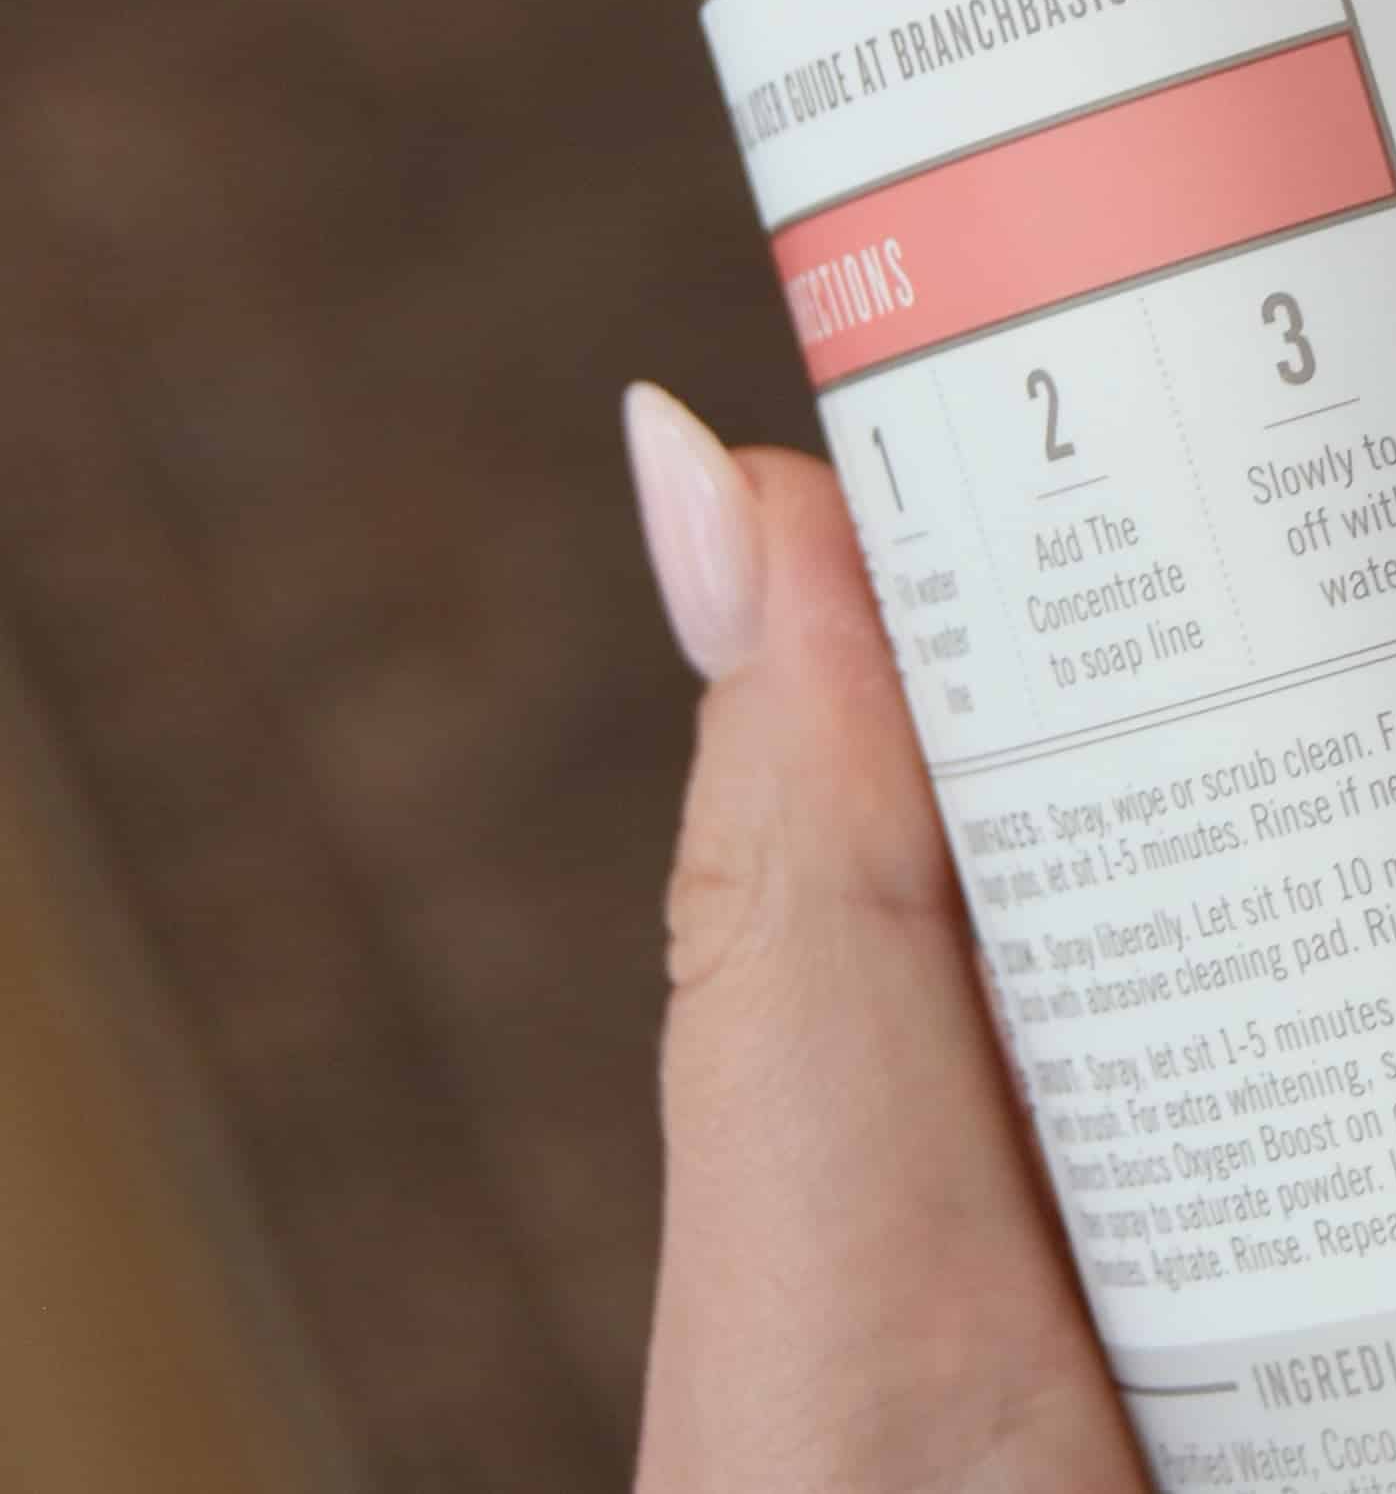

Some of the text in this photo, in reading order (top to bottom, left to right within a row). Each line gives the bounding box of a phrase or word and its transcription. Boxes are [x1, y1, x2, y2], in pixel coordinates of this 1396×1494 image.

[784, 51, 854, 123] GUIDE
[853, 35, 888, 96] AT
[1261, 291, 1316, 387] 3
[1026, 367, 1076, 463] 2
[872, 426, 904, 513] 1
[1246, 439, 1354, 506] Slowly
[1035, 512, 1140, 573] Add The
[1285, 503, 1338, 557] off
[1026, 559, 1187, 634] Concentrate
[1049, 615, 1206, 690] to soap line
[1111, 781, 1168, 826] wipe
[1169, 776, 1195, 810] or
[1199, 749, 1278, 802] scrub
[1281, 737, 1374, 779] clean.
[1098, 837, 1137, 882] 1-5
[1140, 815, 1250, 872] minutes.
[1248, 794, 1334, 843] Rinse
[1334, 775, 1362, 820] if
[1190, 893, 1238, 939] Let
[1240, 883, 1280, 927] sit
[1282, 875, 1324, 915] for
[1332, 856, 1374, 901] 10
[1175, 942, 1290, 996] cleaning
[1292, 917, 1360, 976] pad.
[1182, 1032, 1217, 1072] sit
[1218, 1019, 1268, 1065] 1-5
[1162, 1091, 1224, 1130] extra
[1225, 1058, 1376, 1118] whitening,
[1257, 1115, 1341, 1164] Boost
[1345, 1108, 1384, 1145] on
[1174, 1180, 1273, 1231] saturate
[1275, 1160, 1386, 1224] powder.
[1229, 1234, 1312, 1274] Rinse.
[1232, 1438, 1321, 1482] Water,
